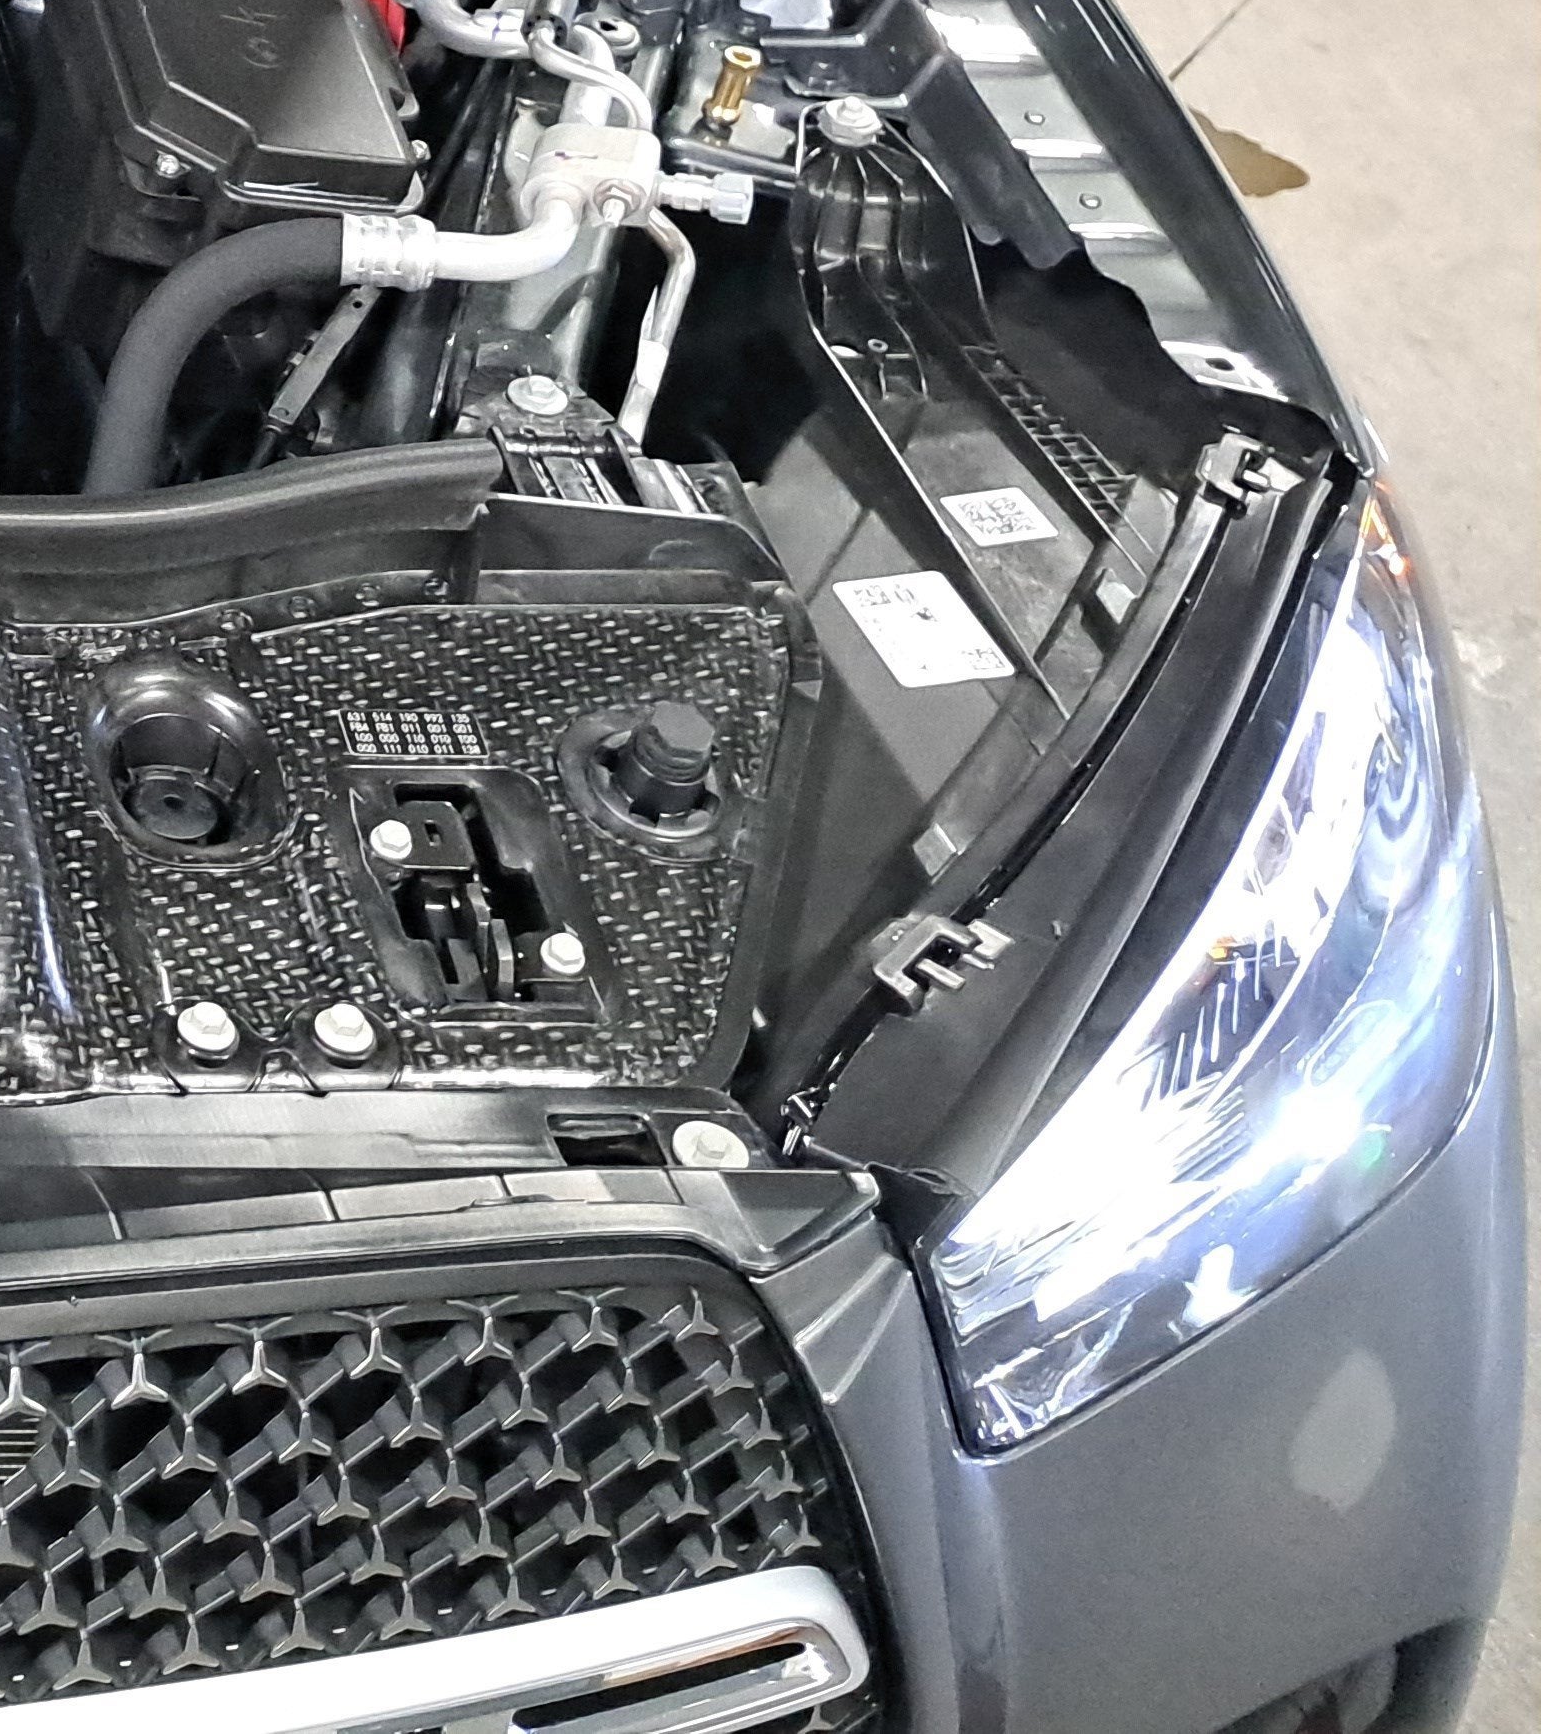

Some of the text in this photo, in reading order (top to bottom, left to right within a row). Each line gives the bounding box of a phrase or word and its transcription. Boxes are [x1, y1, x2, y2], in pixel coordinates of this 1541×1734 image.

[399, 723, 420, 732] 011
[383, 744, 402, 753] 111
[407, 744, 429, 753] 010
[433, 744, 454, 754] 011
